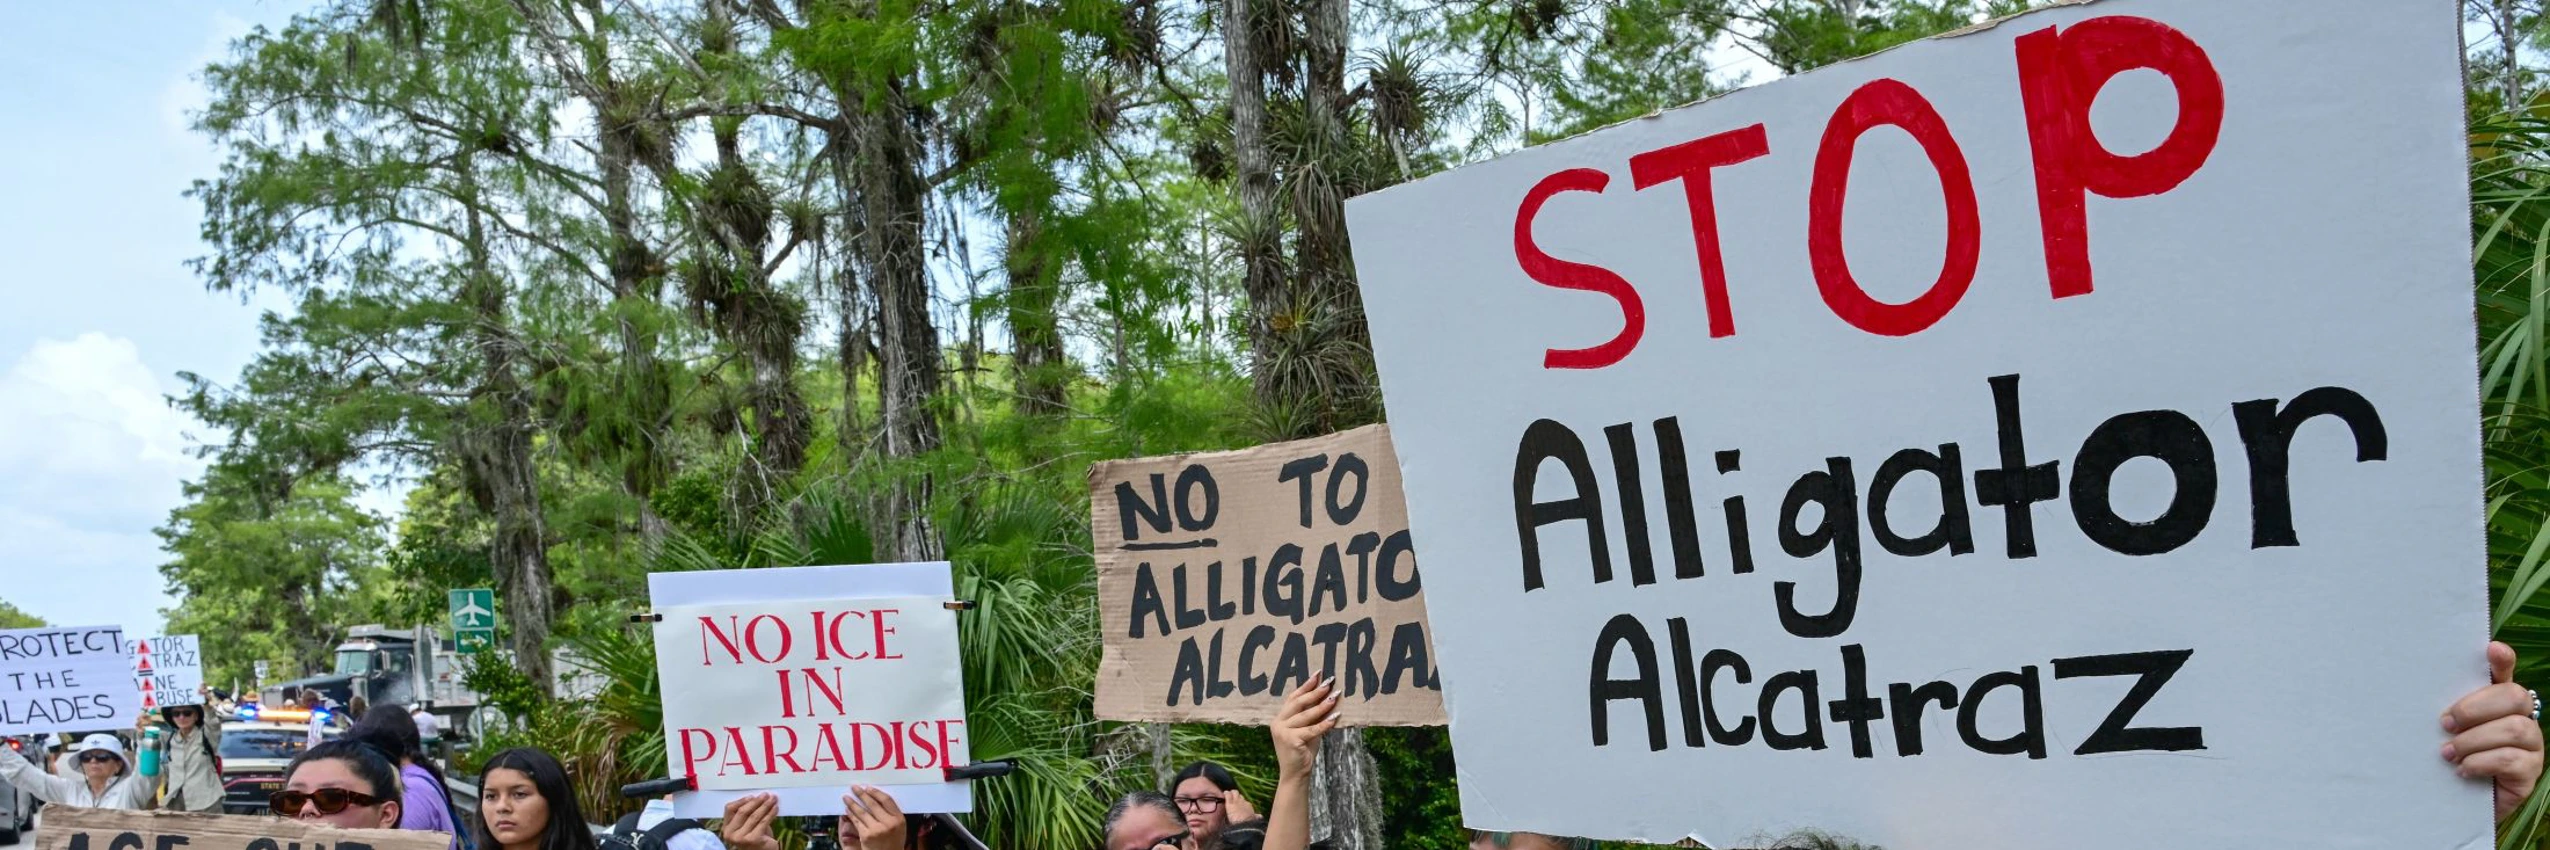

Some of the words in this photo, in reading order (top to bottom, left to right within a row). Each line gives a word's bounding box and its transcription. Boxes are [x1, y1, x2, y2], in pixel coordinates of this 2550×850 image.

[1514, 14, 2225, 370] STOP
[1114, 463, 1220, 541] NO
[1277, 451, 1370, 529] TO
[1512, 373, 2388, 639] Alligator
[1128, 529, 1423, 639] ALLIGATO
[0, 629, 122, 660] ROTECT
[698, 612, 793, 666] NO
[810, 608, 904, 662] ICE
[0, 694, 115, 724] LADES
[8, 669, 80, 691] THE
[776, 666, 846, 719] IN
[1589, 613, 2208, 760] Alcatraz
[677, 718, 968, 778] PARADISE
